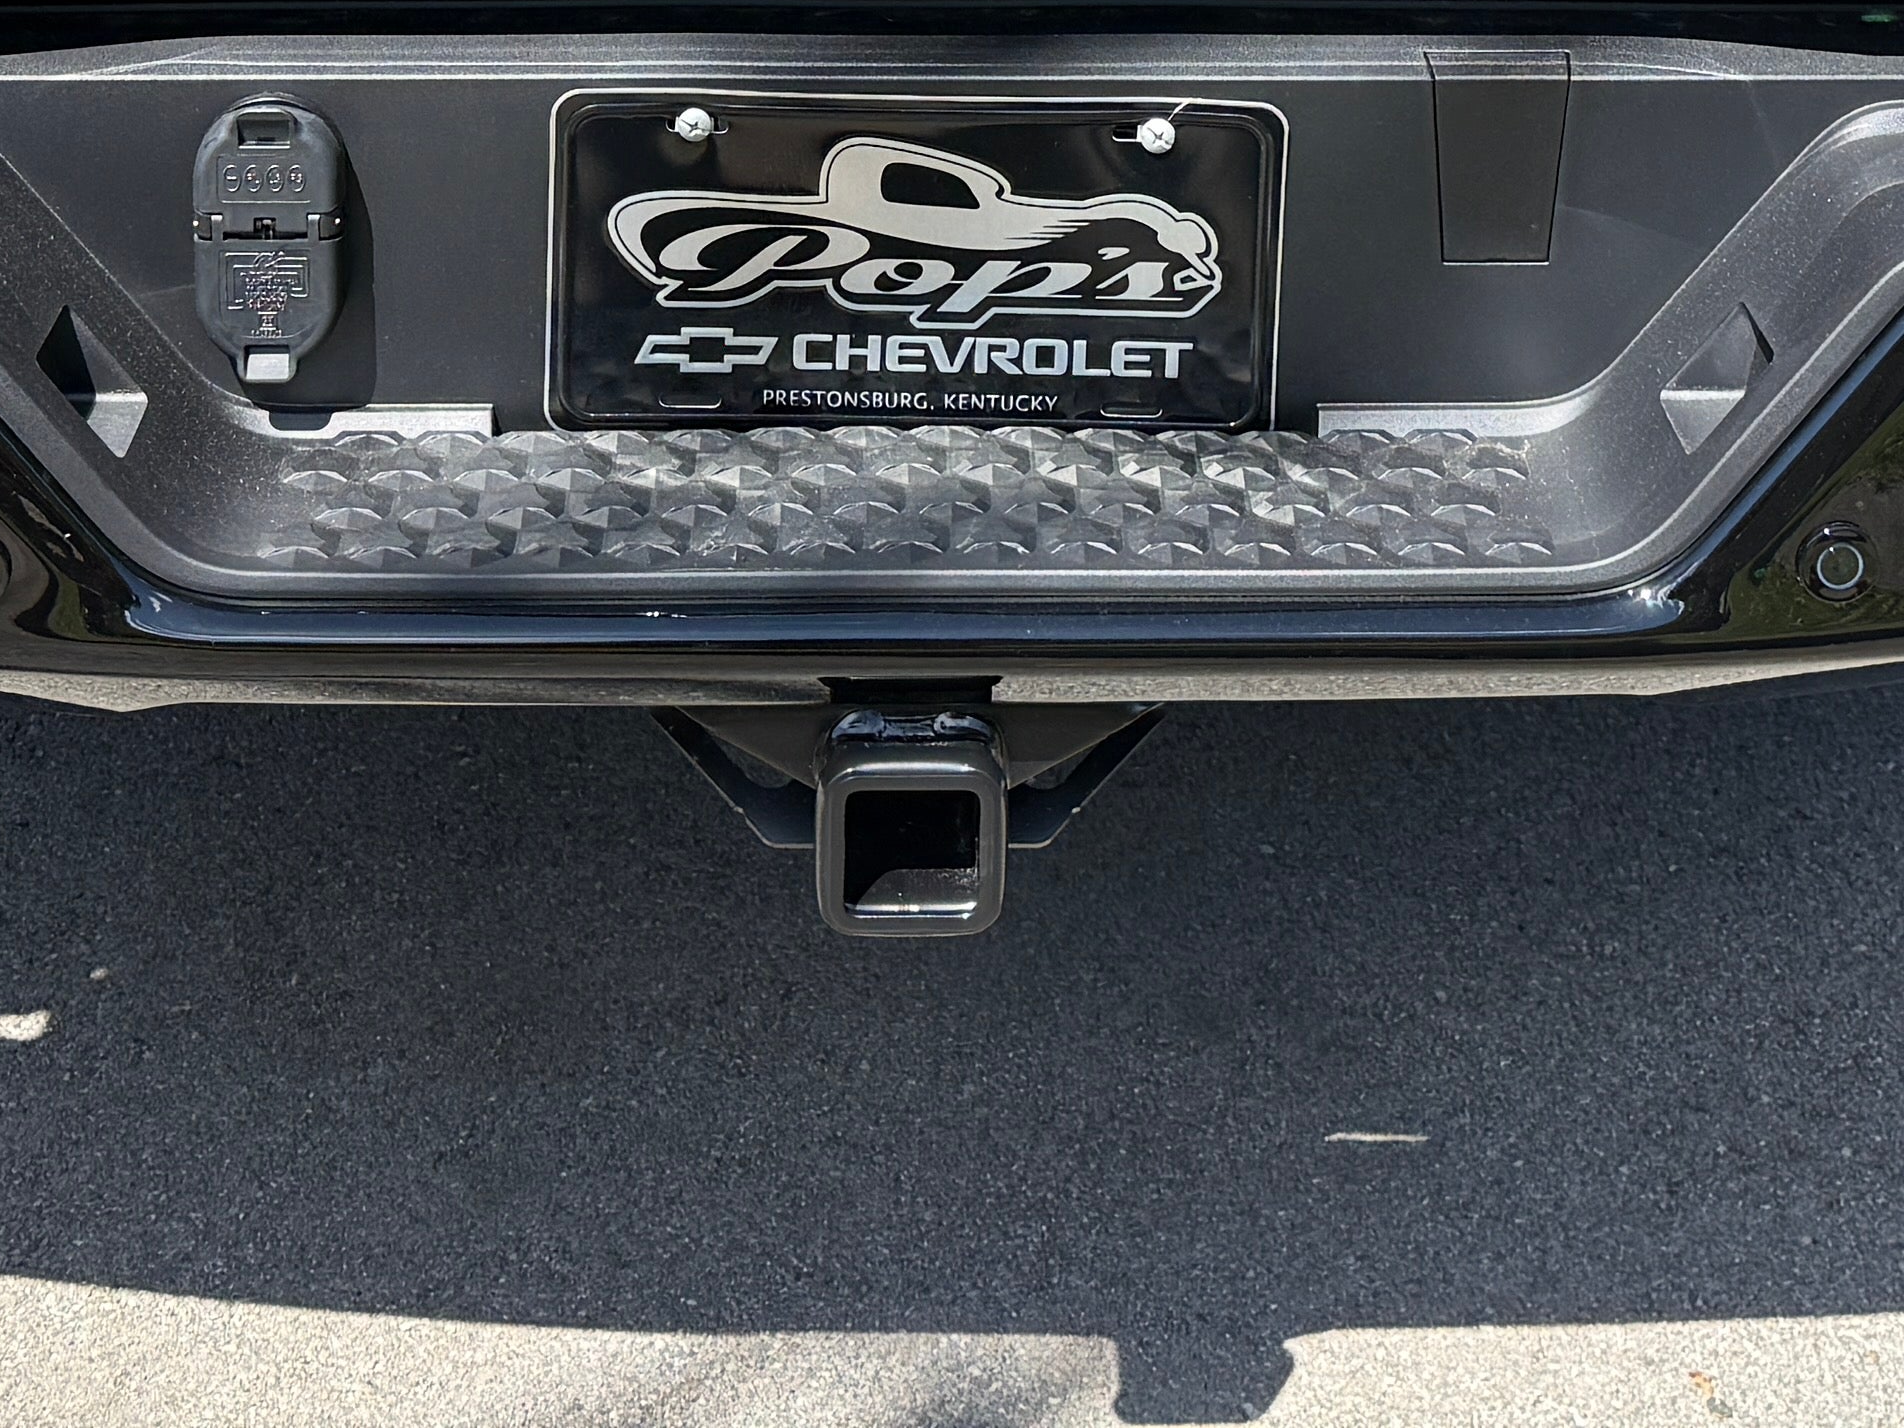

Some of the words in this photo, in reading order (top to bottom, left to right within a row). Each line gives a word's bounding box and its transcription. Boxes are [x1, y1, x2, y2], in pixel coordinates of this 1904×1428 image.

[658, 224, 1184, 313] Pop's
[792, 333, 1194, 379] CHEVROLET
[944, 393, 1058, 412] KENTUCKY
